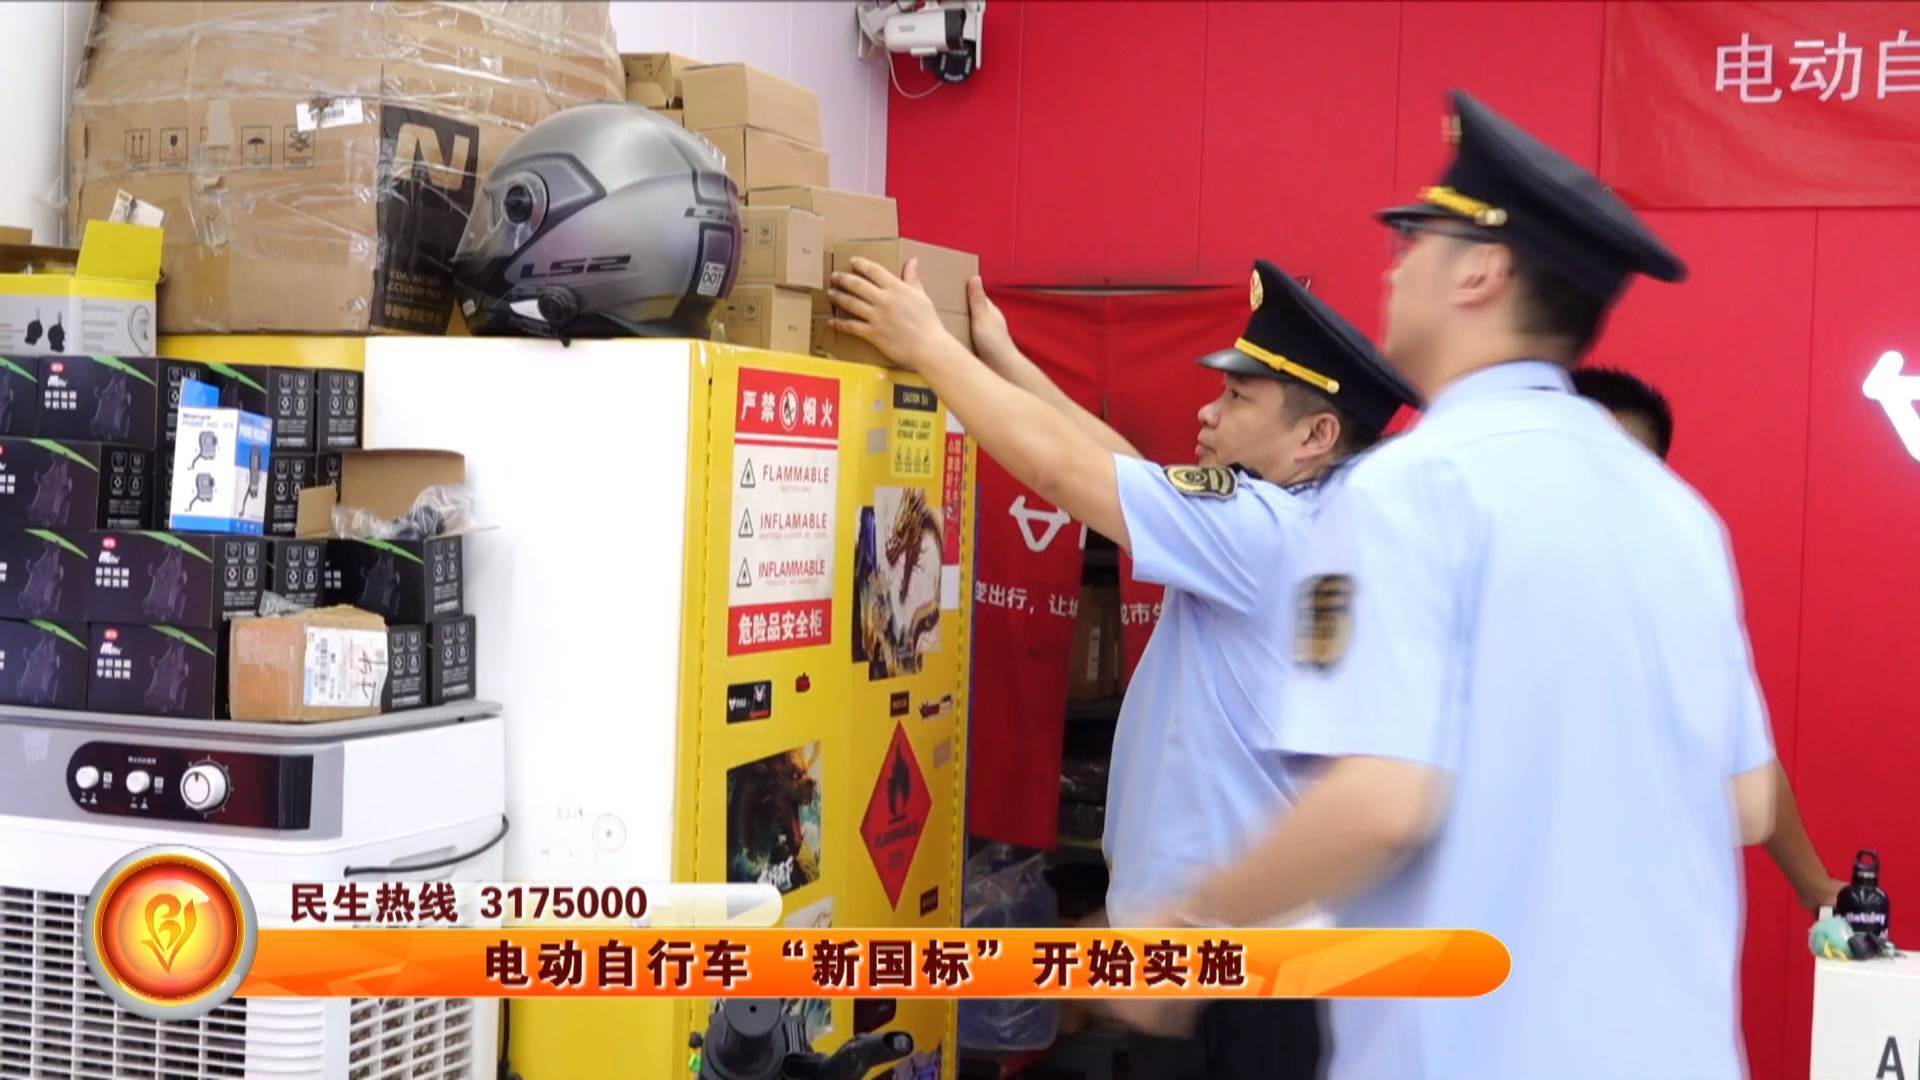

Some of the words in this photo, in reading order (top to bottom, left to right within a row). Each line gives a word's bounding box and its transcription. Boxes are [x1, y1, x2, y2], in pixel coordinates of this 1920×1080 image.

[519, 254, 632, 279] LS2
[740, 389, 776, 422] 严禁
[802, 397, 834, 428] 烟火
[761, 464, 830, 486] FLAMMABLE
[759, 511, 828, 531] INFLAMABLE
[757, 558, 827, 578] INFLAMMABLE
[737, 607, 823, 647] 危险品安全柜
[1875, 1035, 1920, 1080] A
